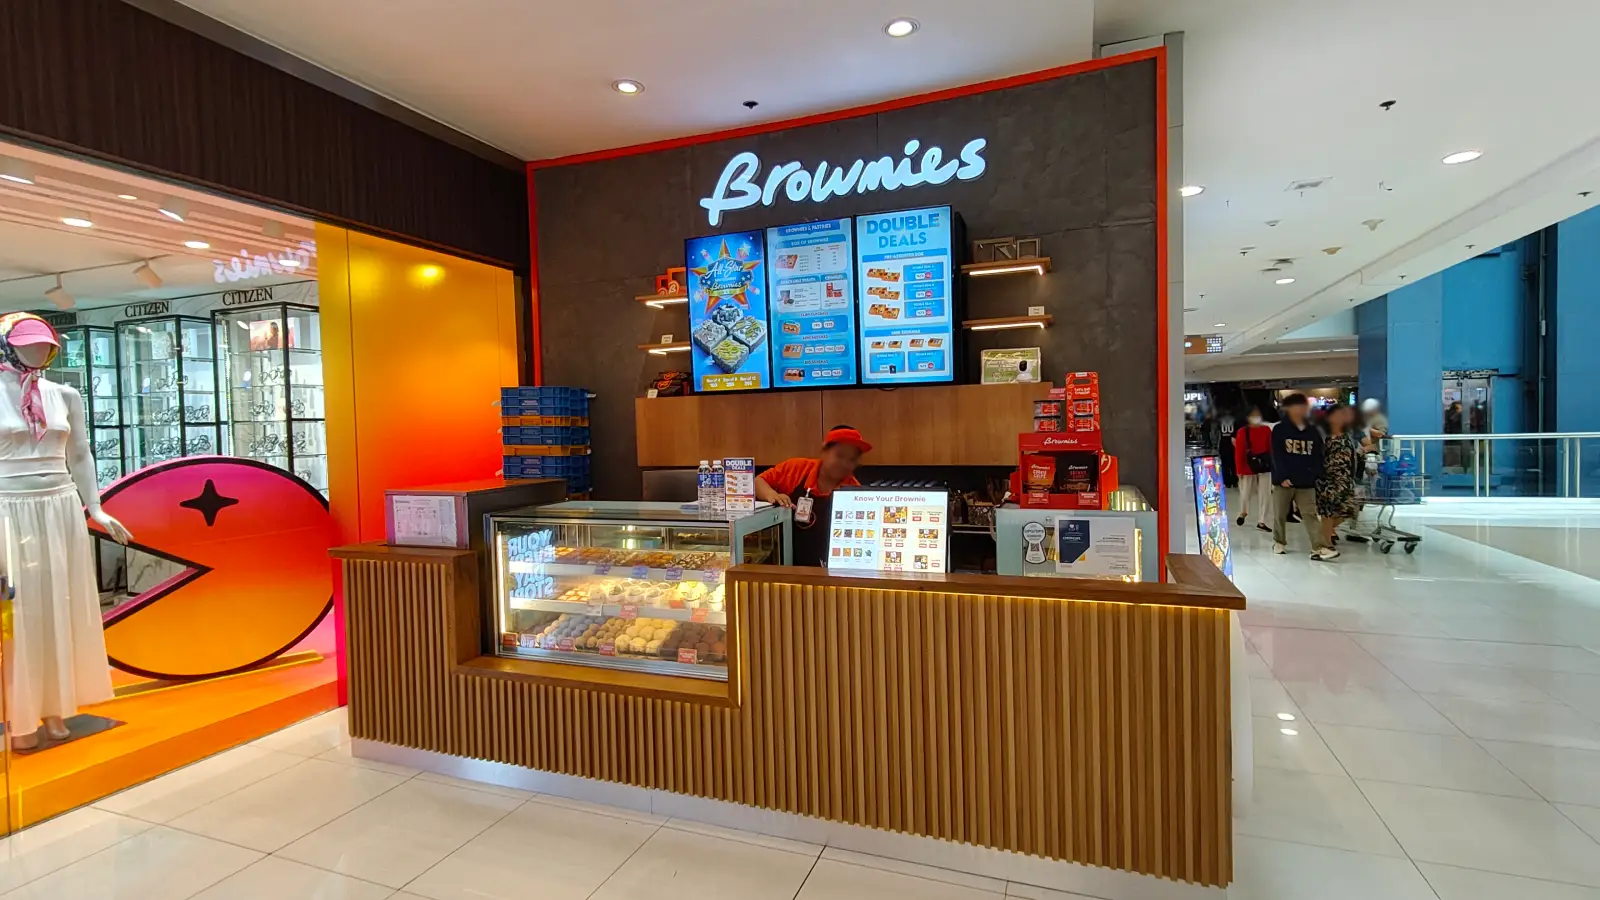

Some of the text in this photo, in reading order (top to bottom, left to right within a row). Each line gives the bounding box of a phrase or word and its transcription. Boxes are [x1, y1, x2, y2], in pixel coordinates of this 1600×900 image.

[700, 138, 987, 227] Brownies
[812, 223, 832, 231] PASTRIES
[867, 213, 941, 235] DOUBLE
[879, 232, 927, 249] DEALS
[705, 259, 744, 279] All-Star
[222, 287, 274, 307] CITIZEN
[125, 300, 170, 319] CITIZEN
[1042, 437, 1078, 446] Brownies
[1285, 438, 1314, 456] SELF
